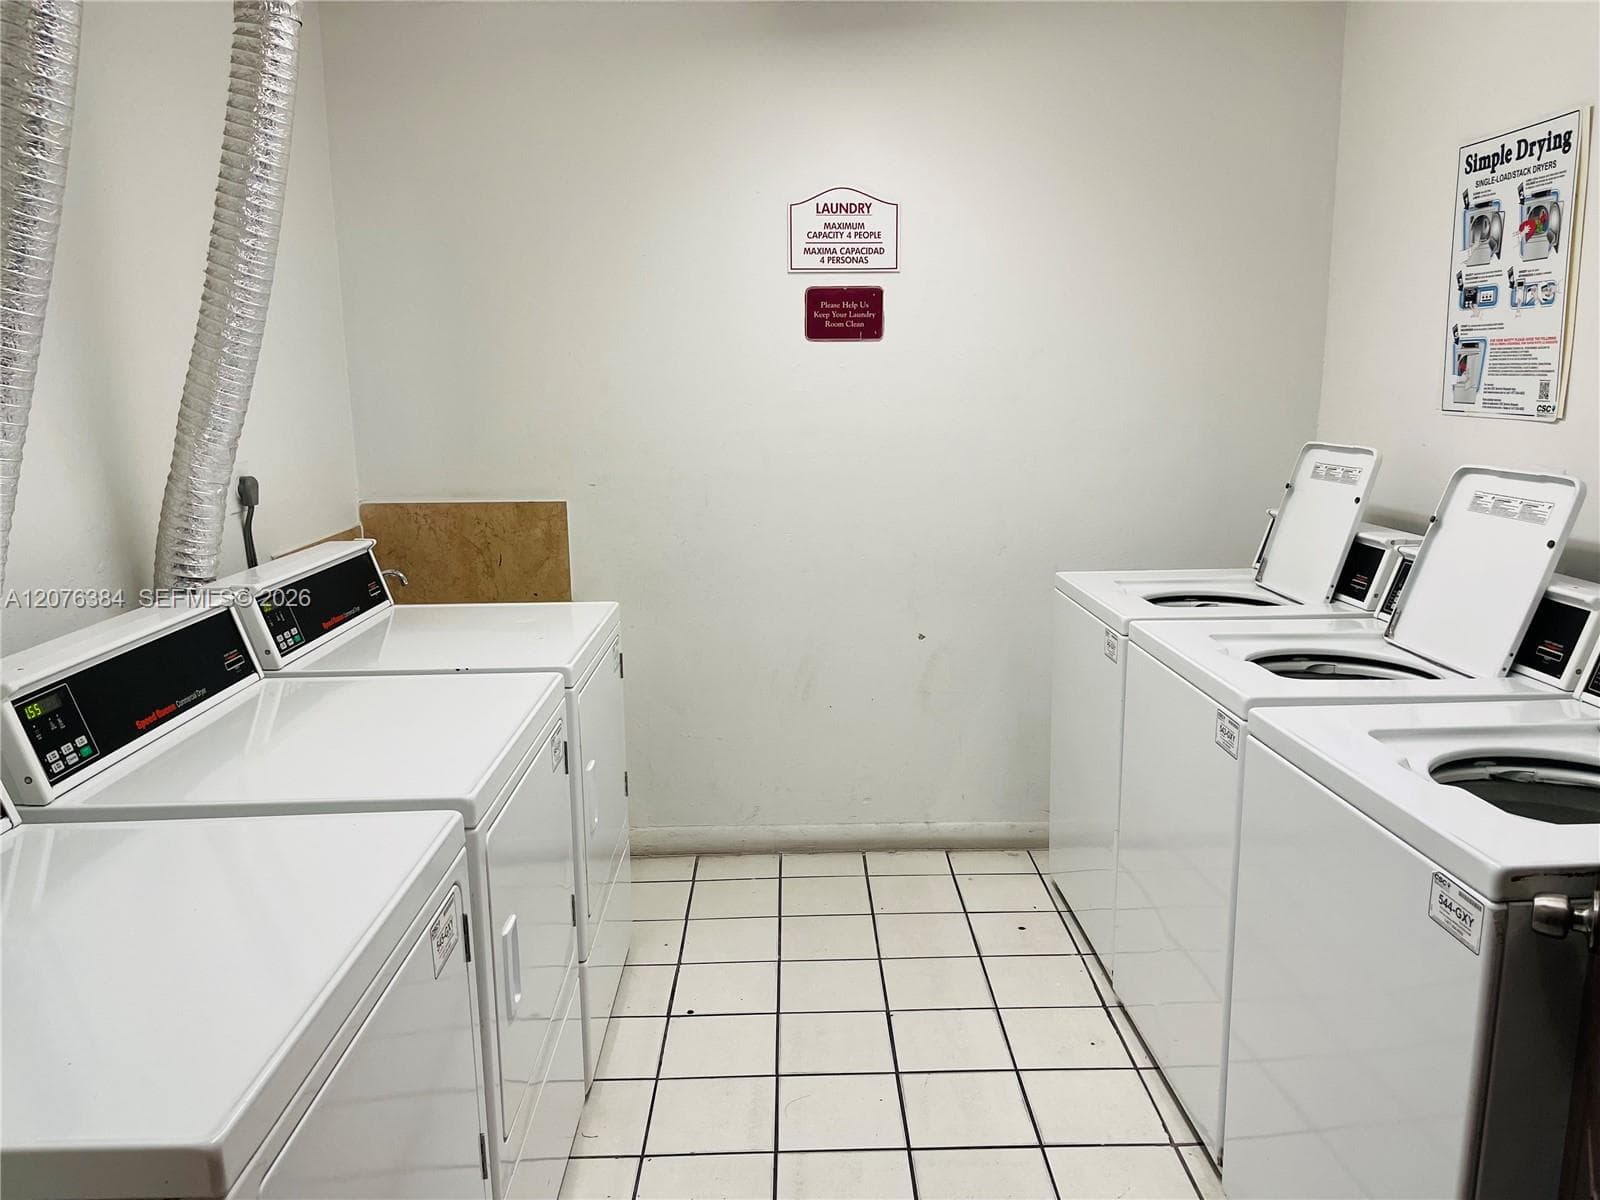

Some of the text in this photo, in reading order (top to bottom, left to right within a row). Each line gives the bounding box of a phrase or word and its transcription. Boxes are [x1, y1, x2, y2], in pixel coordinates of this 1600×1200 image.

[1464, 130, 1573, 175] Simple Drying
[1533, 160, 1557, 174] DRYERS
[815, 202, 873, 214] LAUNDRY
[823, 222, 865, 230] MAXIMUM
[806, 231, 882, 239] CAPACITY 4 PEOPLE
[803, 247, 885, 255] MAXIMA CAPACIDAD
[819, 256, 869, 264] 4 PERSONAS
[820, 301, 870, 310] Please Help Us
[813, 311, 830, 319] Keep
[848, 311, 876, 319] Laundry
[824, 320, 865, 328] Room Clean
[1536, 404, 1552, 413] CSC
[1438, 893, 1475, 928] 544-GXY
